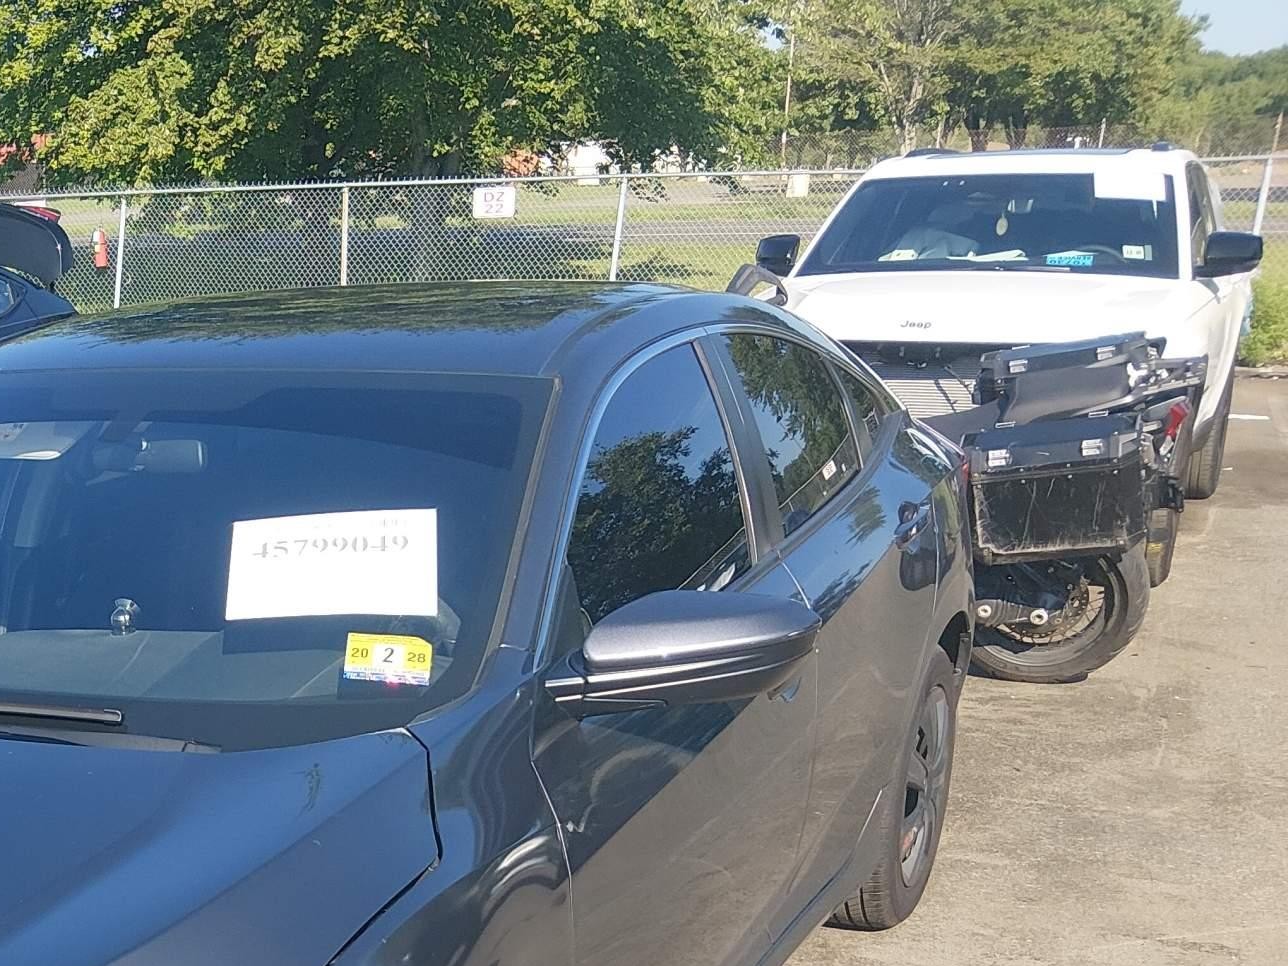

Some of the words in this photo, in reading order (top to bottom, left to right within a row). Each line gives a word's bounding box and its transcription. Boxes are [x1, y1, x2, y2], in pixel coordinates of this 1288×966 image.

[484, 191, 505, 202] DZ
[485, 203, 504, 213] 22
[899, 320, 932, 330] Jeep
[251, 535, 410, 559] 45799049
[351, 647, 369, 658] 20
[381, 647, 395, 664] 2
[407, 651, 427, 664] 28
